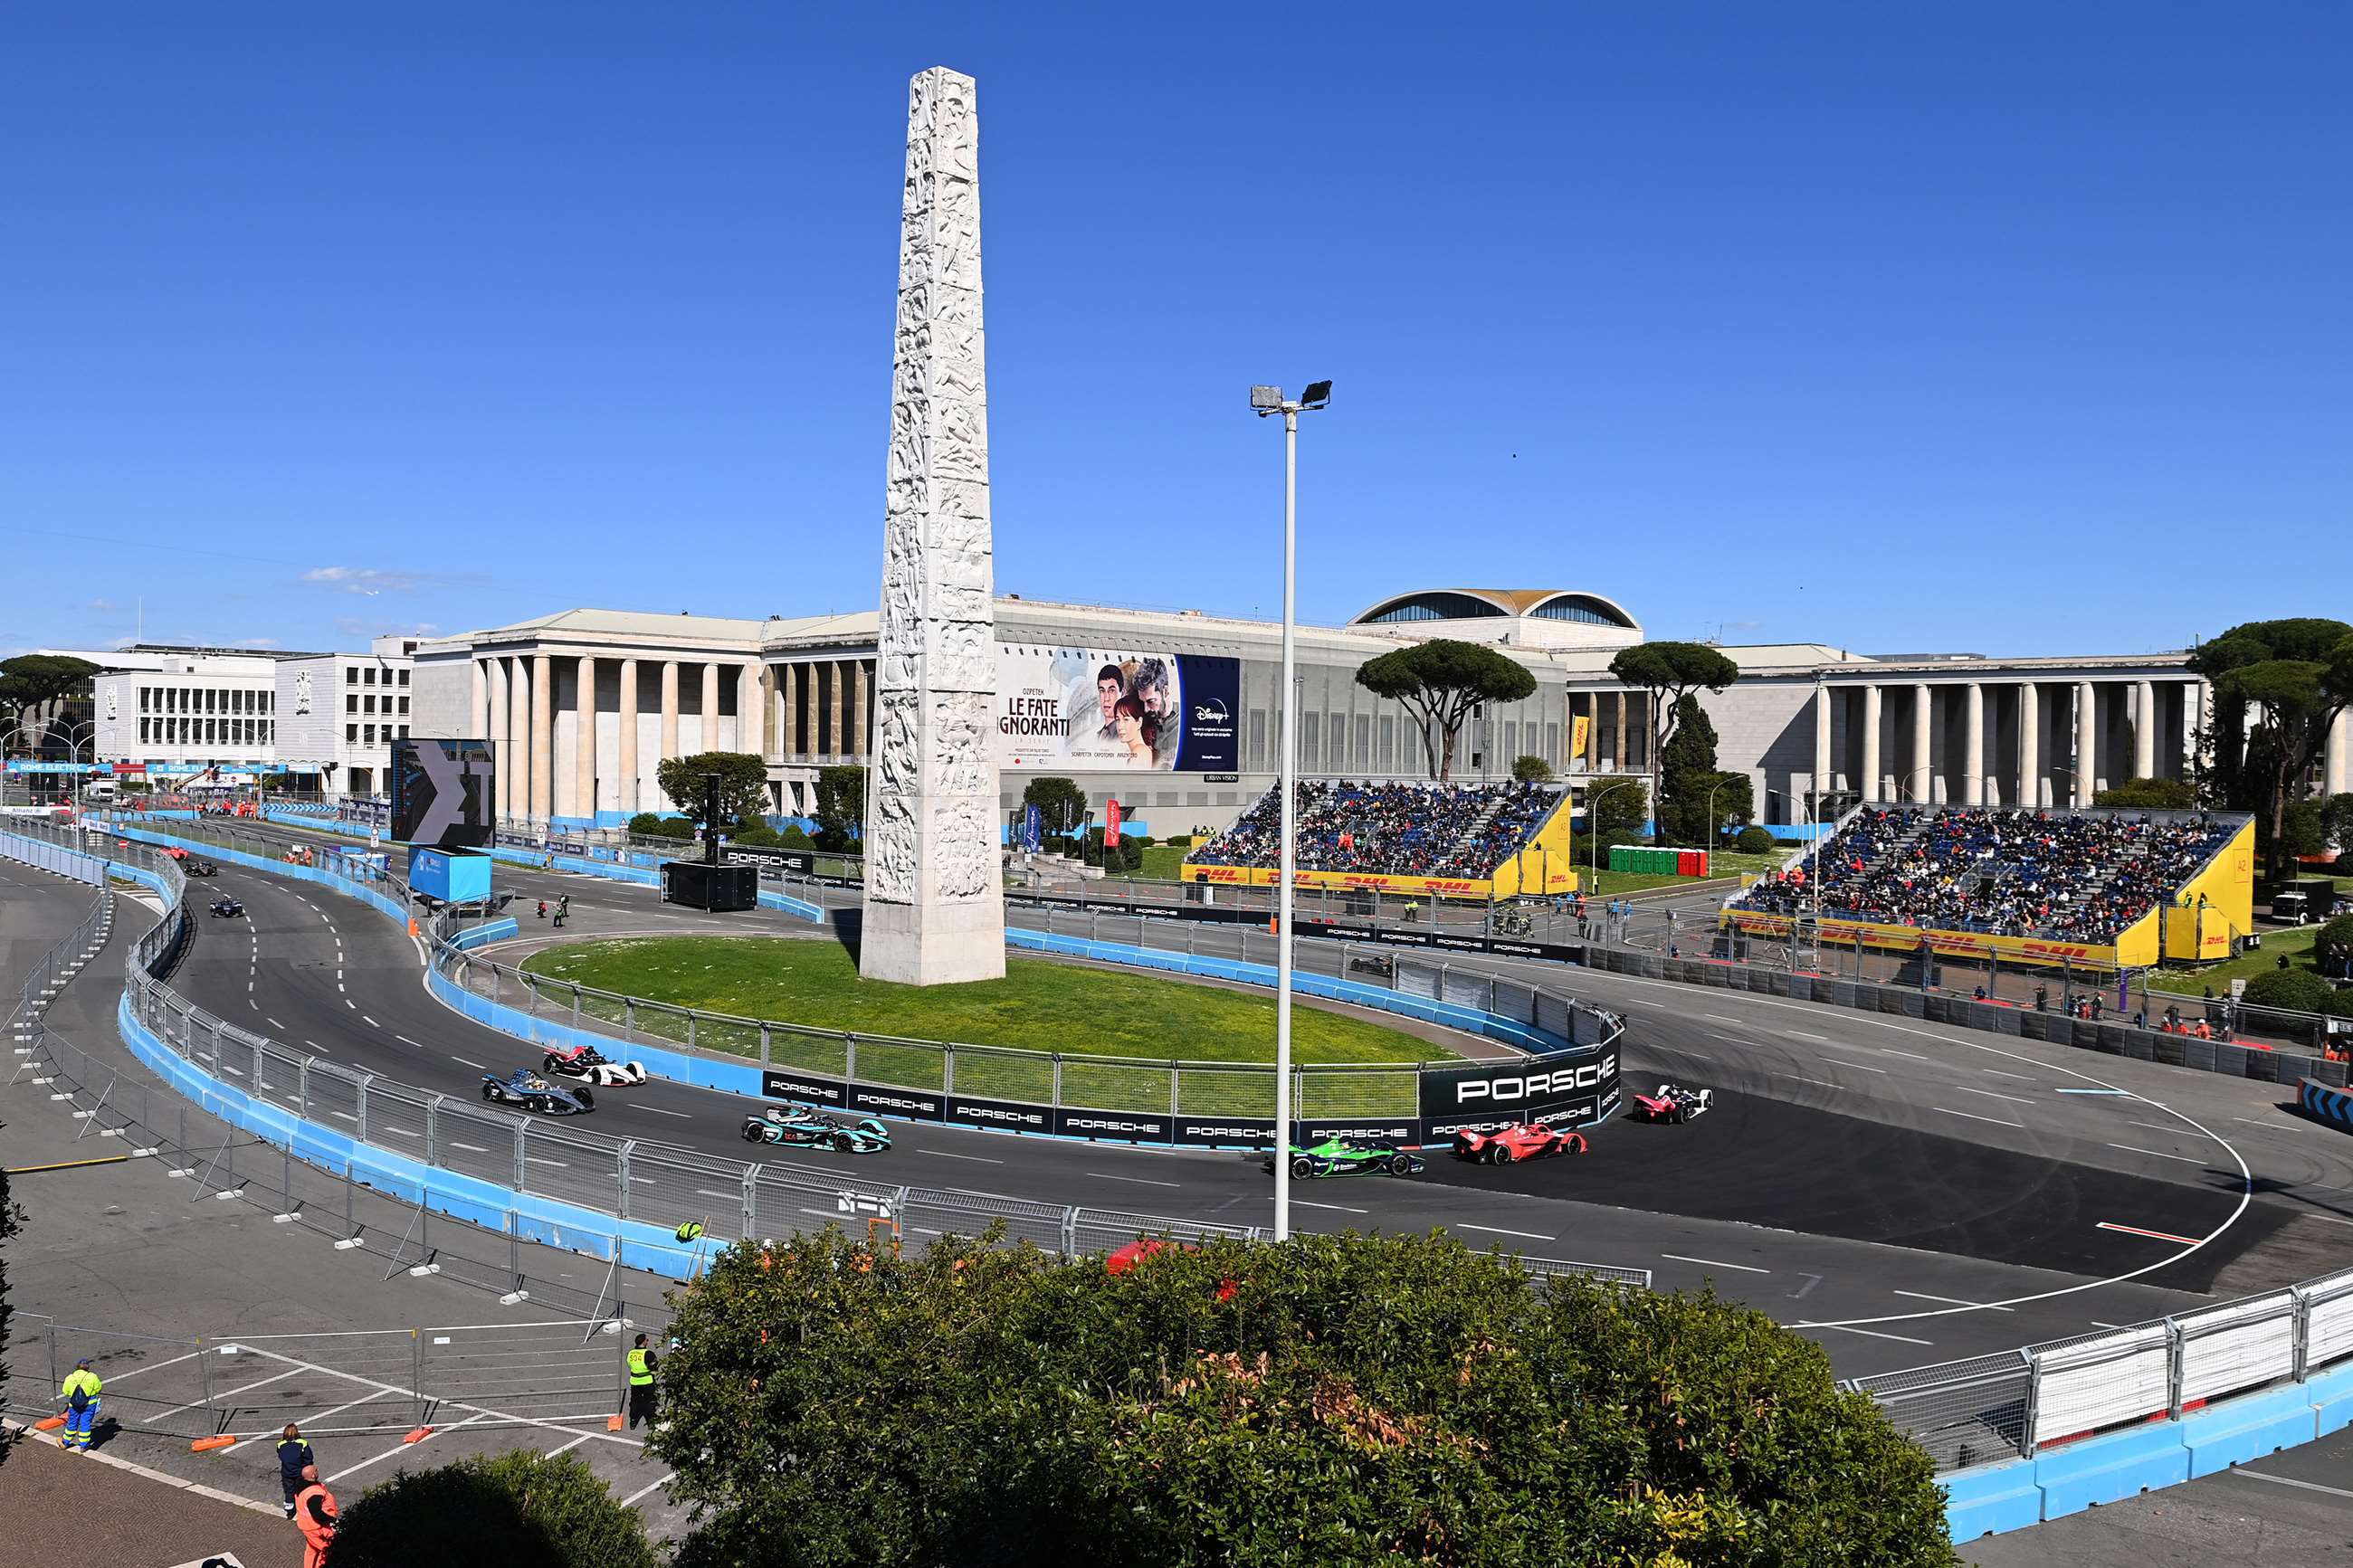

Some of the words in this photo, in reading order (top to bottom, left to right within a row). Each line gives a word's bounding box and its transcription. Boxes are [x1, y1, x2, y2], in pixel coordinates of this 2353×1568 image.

[1009, 698, 1024, 715] LE
[1028, 698, 1058, 717] FATE
[728, 852, 802, 869] PORSCHE
[1195, 869, 1239, 881] DHL
[1344, 877, 1392, 889] DHL
[1424, 880, 1473, 894] DHL
[1087, 904, 1126, 912] PORSCHE
[1136, 908, 1177, 916] PORSCHE
[1327, 928, 1370, 938] PORSCHE
[1381, 933, 1426, 943] PORSCHE
[1437, 938, 1482, 948] PORSCHE
[1915, 933, 1980, 950] DHL
[2206, 936, 2225, 945] DHL
[1493, 944, 1541, 954] PORSCHE
[2020, 943, 2092, 964] DHL
[1457, 1054, 1615, 1103] PORSCHE
[771, 1080, 839, 1098] PORSCHE
[857, 1094, 935, 1112] PORSCHE
[1601, 1087, 1620, 1107] PORSCHE
[957, 1107, 1043, 1124] PORSCHE
[1535, 1106, 1592, 1125] PORSCHE
[1066, 1118, 1160, 1134] PORSCHE
[1186, 1126, 1277, 1138] PORSCHE
[1432, 1121, 1513, 1136] PORSCHE
[1312, 1128, 1408, 1139] PORSCHE
